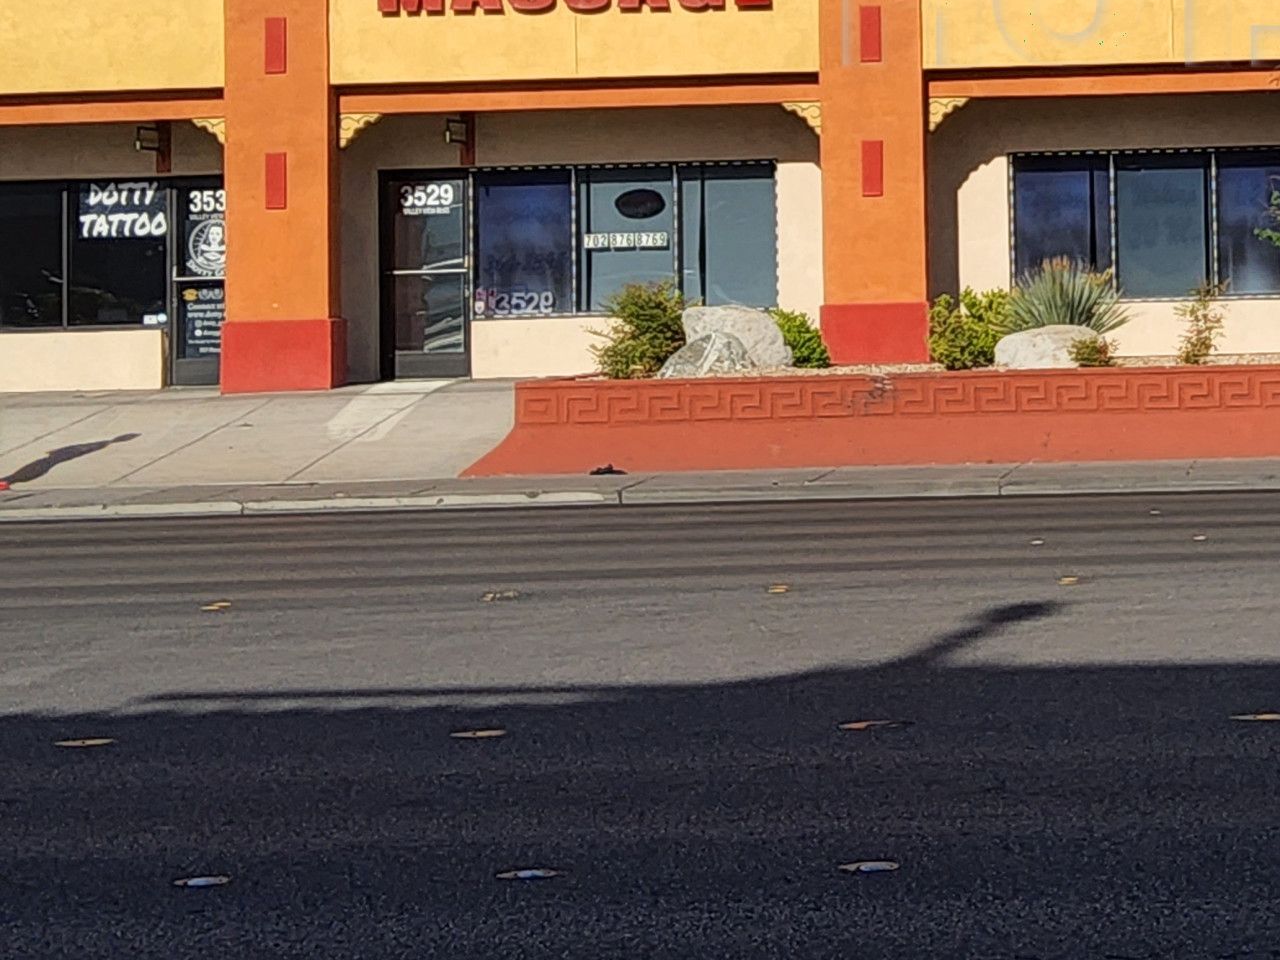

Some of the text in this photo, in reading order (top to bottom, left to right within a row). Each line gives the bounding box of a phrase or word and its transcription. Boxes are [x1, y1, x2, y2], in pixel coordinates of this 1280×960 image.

[88, 181, 158, 205] DOTTY
[400, 184, 454, 207] 3529
[79, 212, 167, 238] TATTOO
[585, 233, 666, 248] 702 876 8769
